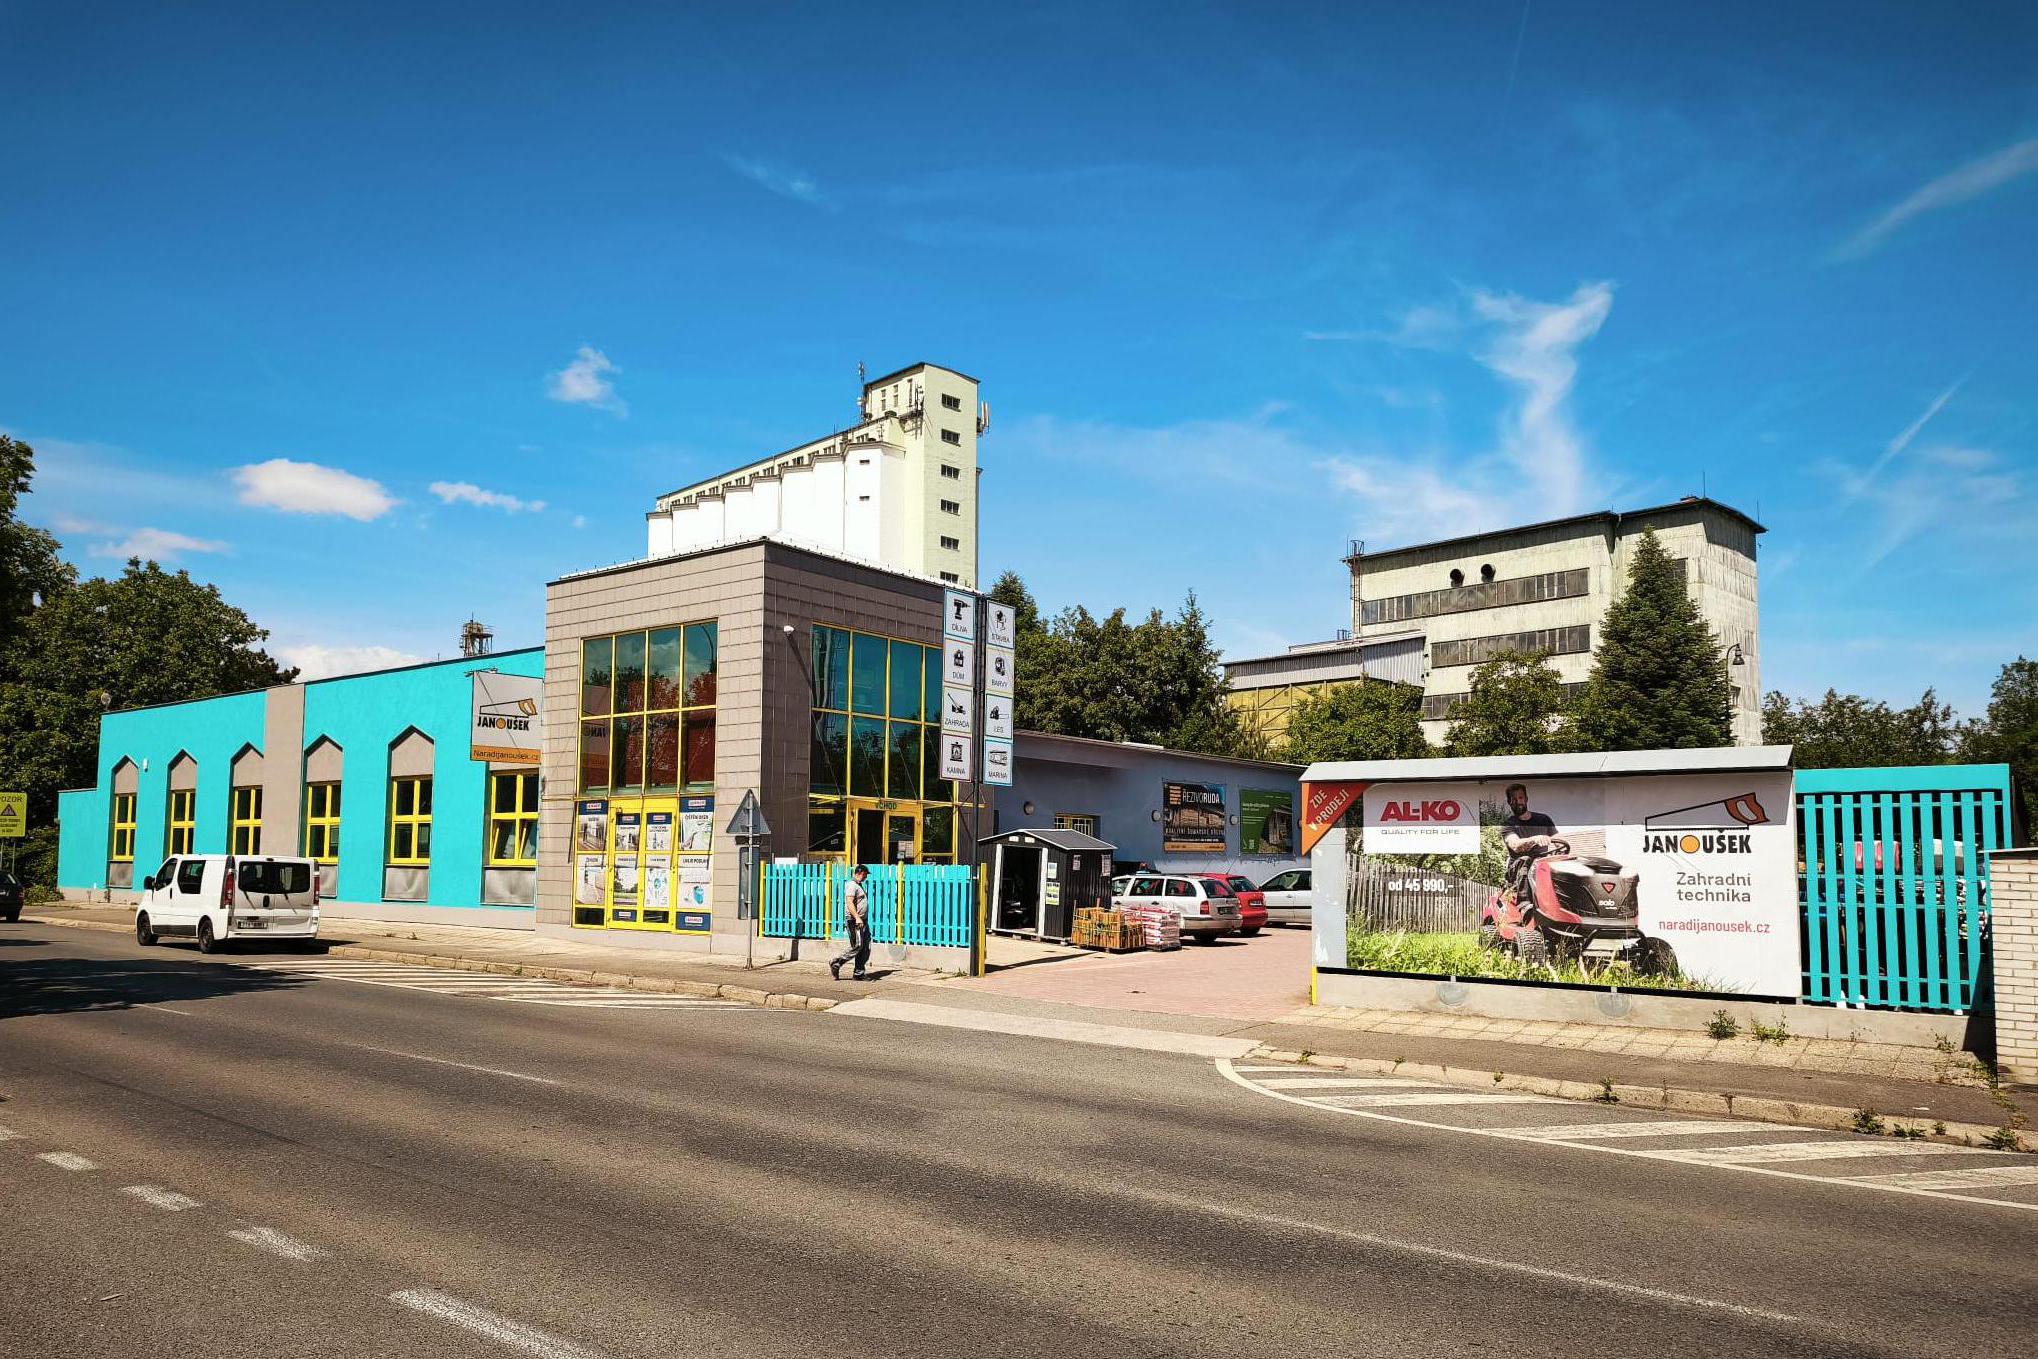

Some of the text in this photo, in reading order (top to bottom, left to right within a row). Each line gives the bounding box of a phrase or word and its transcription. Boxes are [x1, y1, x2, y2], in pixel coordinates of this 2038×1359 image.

[944, 717, 970, 729] ZAHRADA
[0, 795, 23, 803] OZOR
[1309, 789, 1328, 809] ZDE
[1315, 789, 1350, 826] PRODEJI
[1380, 800, 1461, 822] AL-KO
[1643, 830, 1752, 854] JANOUŠEK
[1388, 879, 1402, 891] od
[1405, 879, 1421, 892] 45
[1677, 888, 1751, 902] technika
[1659, 919, 1771, 934] naradijanousek.cz
